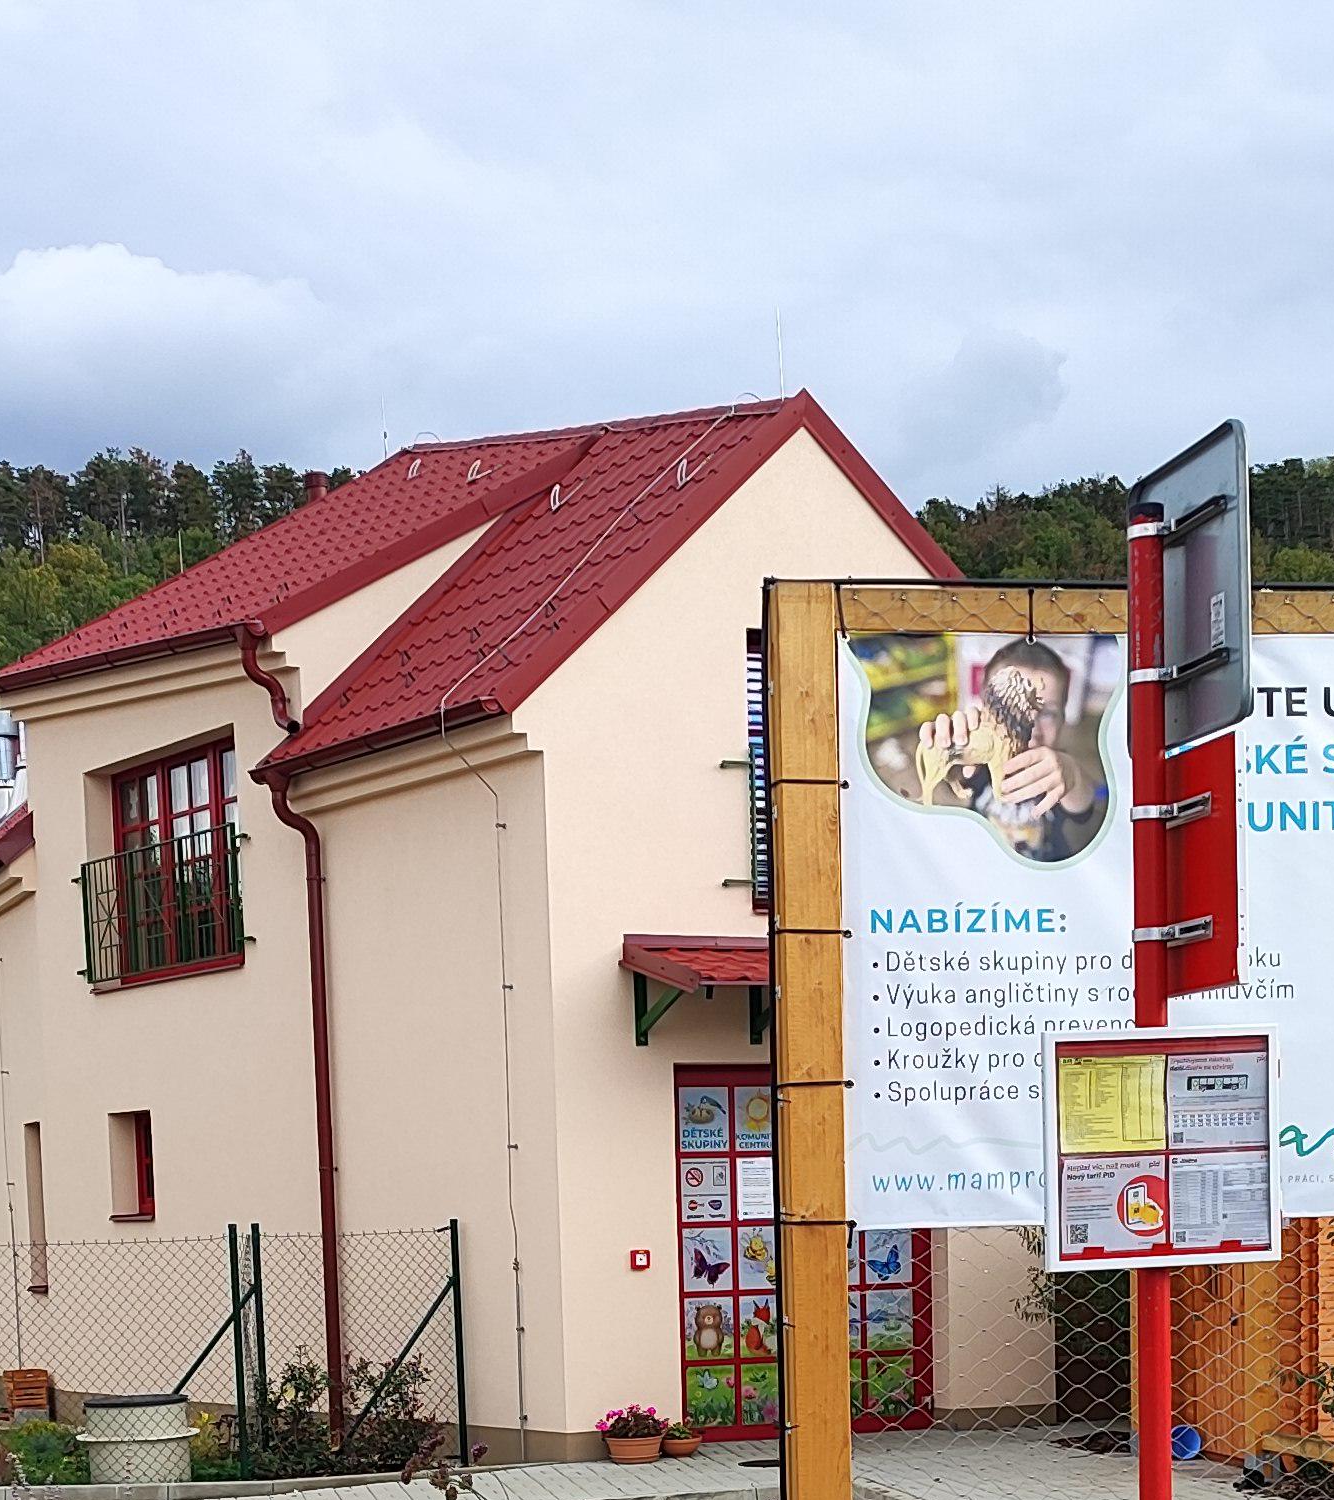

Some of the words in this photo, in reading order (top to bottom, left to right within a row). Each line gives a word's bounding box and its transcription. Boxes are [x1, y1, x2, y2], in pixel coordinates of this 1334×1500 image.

[870, 902, 1067, 933] NABÍZÍME:
[886, 949, 970, 972] Dětské
[978, 949, 1067, 975] skupiny
[1076, 953, 1112, 974] pro
[886, 982, 956, 1009] Výuka
[965, 981, 1079, 1009] angličtiny
[1088, 987, 1099, 1002] s
[887, 1014, 1035, 1042] Logopedická
[887, 1048, 980, 1074] Kroužky
[988, 1052, 1025, 1073] pro
[887, 1079, 1019, 1107] Spolupráce
[681, 1140, 728, 1149] SKUPINY
[682, 1127, 724, 1138] DĚTSKÉ
